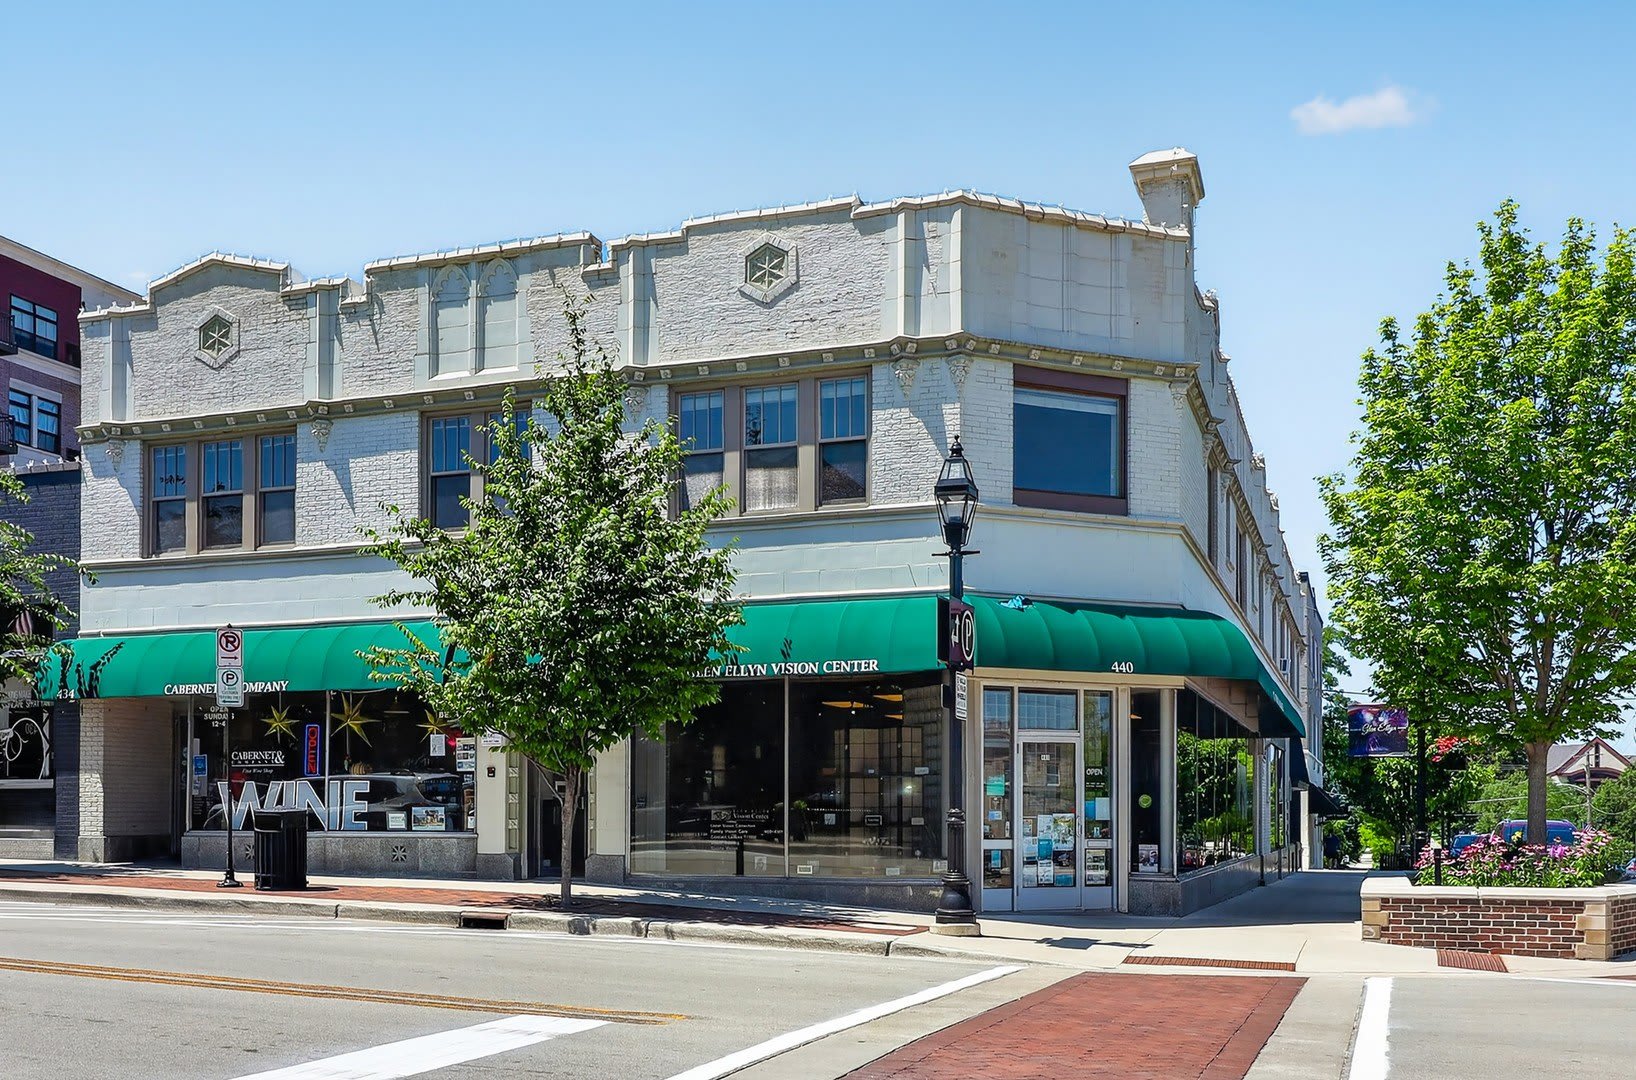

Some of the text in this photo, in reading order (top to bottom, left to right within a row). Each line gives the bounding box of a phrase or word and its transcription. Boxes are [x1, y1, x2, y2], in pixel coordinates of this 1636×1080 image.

[687, 659, 879, 678] LEN ELLYN VISION CENTER
[1111, 661, 1134, 674] 440
[242, 681, 289, 693] OMPANY
[57, 688, 75, 699] 434
[307, 727, 318, 774] OPEN
[1086, 768, 1103, 776] OPEN
